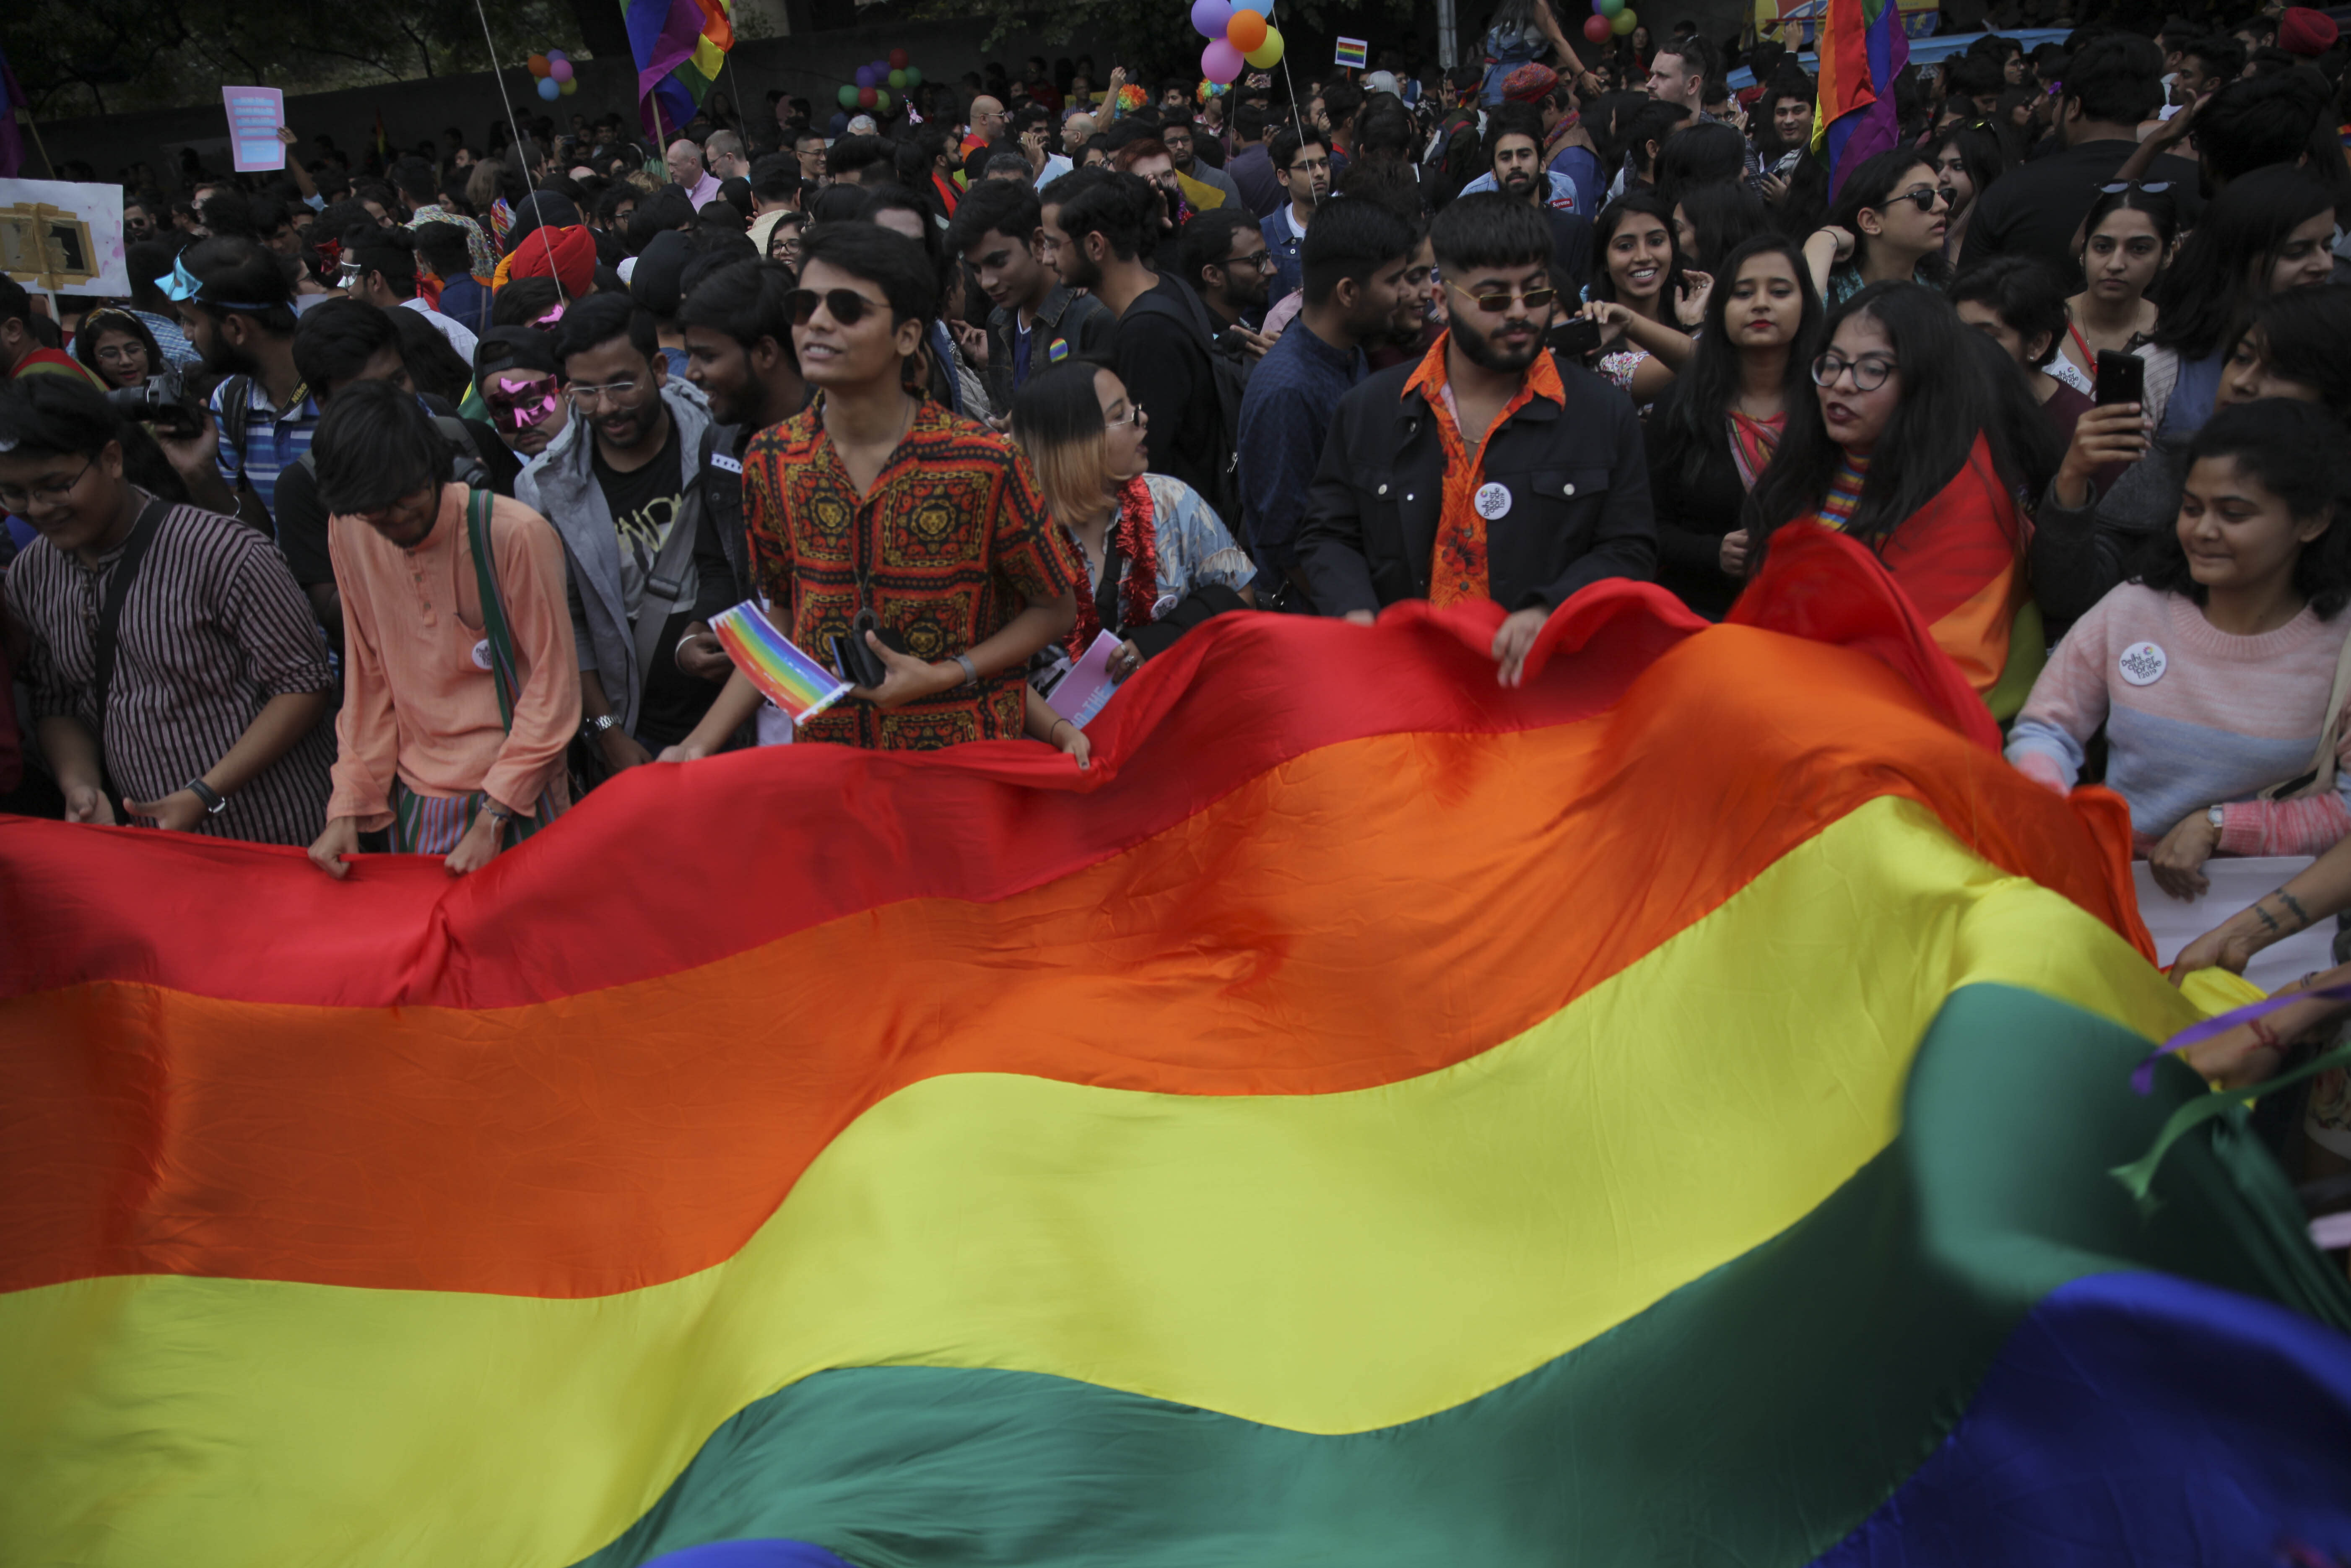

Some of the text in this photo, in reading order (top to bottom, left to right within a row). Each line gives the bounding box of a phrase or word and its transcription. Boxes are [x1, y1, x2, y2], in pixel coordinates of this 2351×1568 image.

[291, 382, 308, 403] Niko
[1489, 491, 1498, 513] queer
[2121, 653, 2142, 667] Delhi
[2128, 656, 2154, 673] queer
[2136, 659, 2161, 679] pride
[2141, 669, 2157, 679] 2019
[1082, 685, 1110, 714] THE
